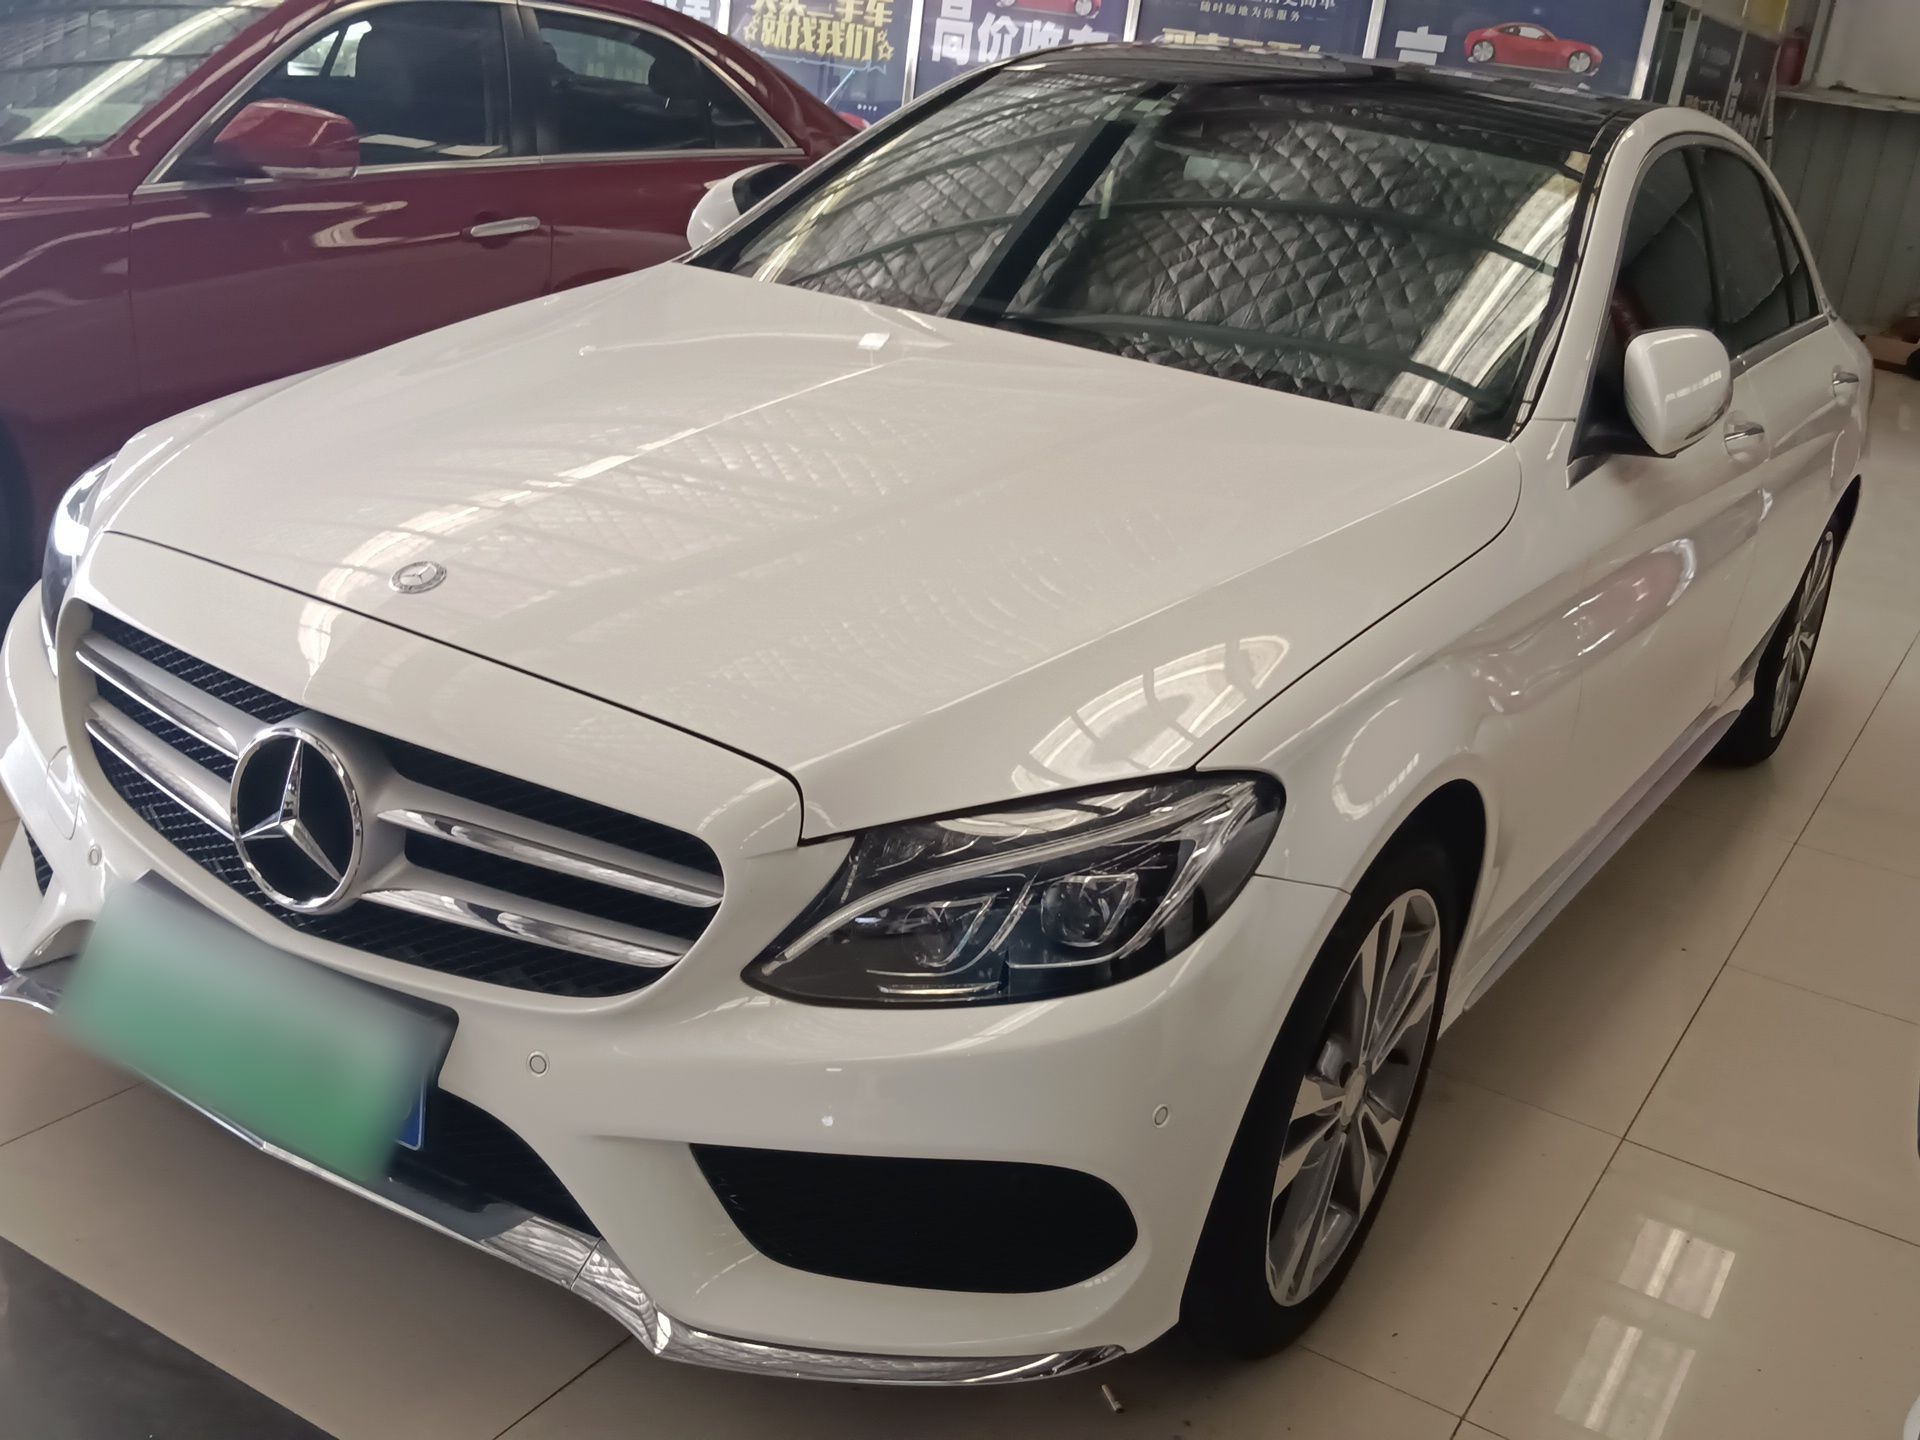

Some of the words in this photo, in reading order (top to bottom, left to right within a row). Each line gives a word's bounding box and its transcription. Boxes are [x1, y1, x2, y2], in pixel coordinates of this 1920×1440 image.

[1199, 0, 1300, 22] 随时随地为你服务
[760, 11, 876, 62] 就找我们
